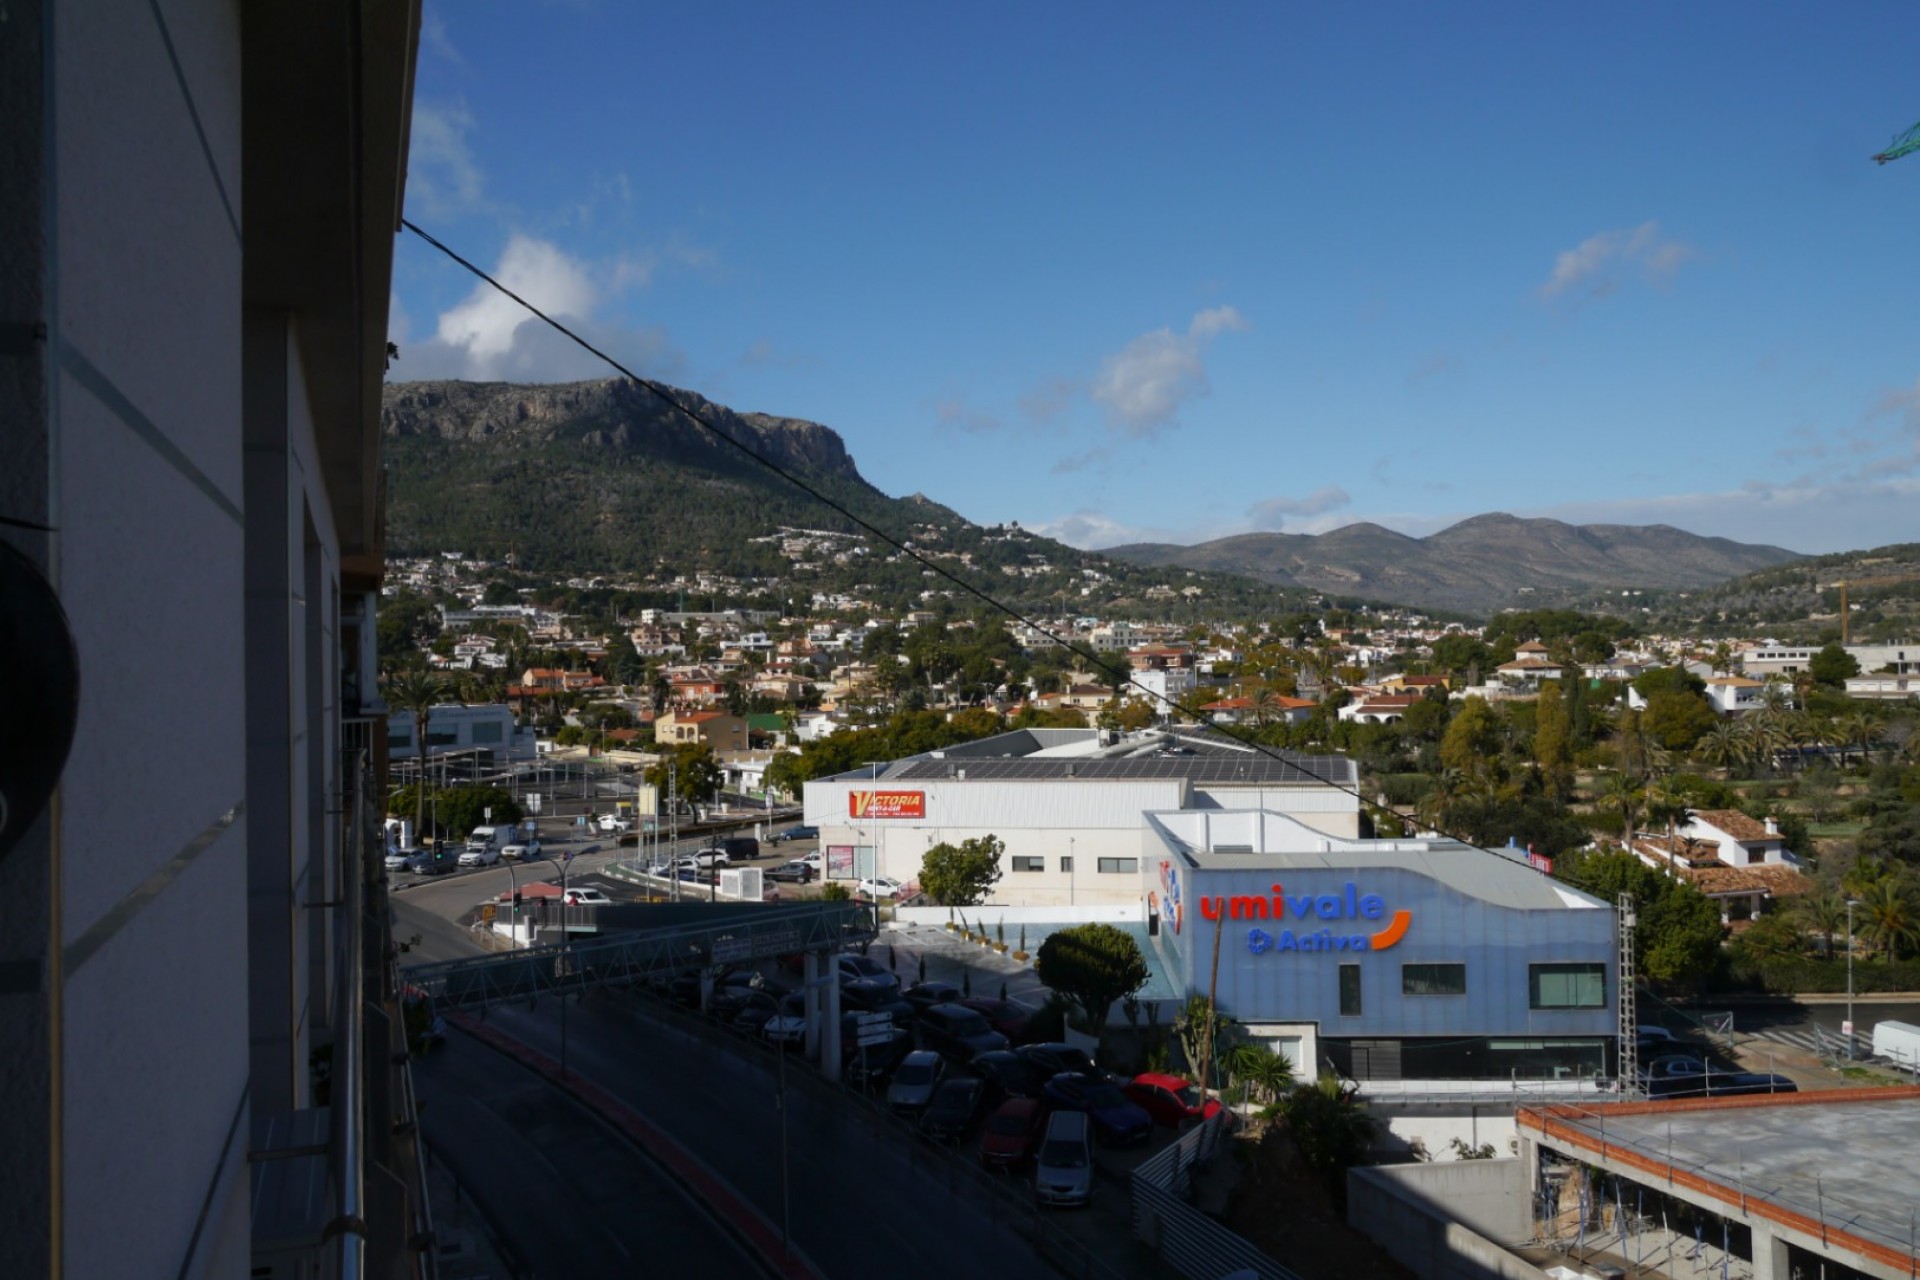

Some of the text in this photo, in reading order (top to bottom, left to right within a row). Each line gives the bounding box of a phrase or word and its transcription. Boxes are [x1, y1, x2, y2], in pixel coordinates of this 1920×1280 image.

[853, 791, 920, 816] VICTORIA
[1200, 882, 1384, 920] umivale
[1277, 928, 1368, 951] Activa
